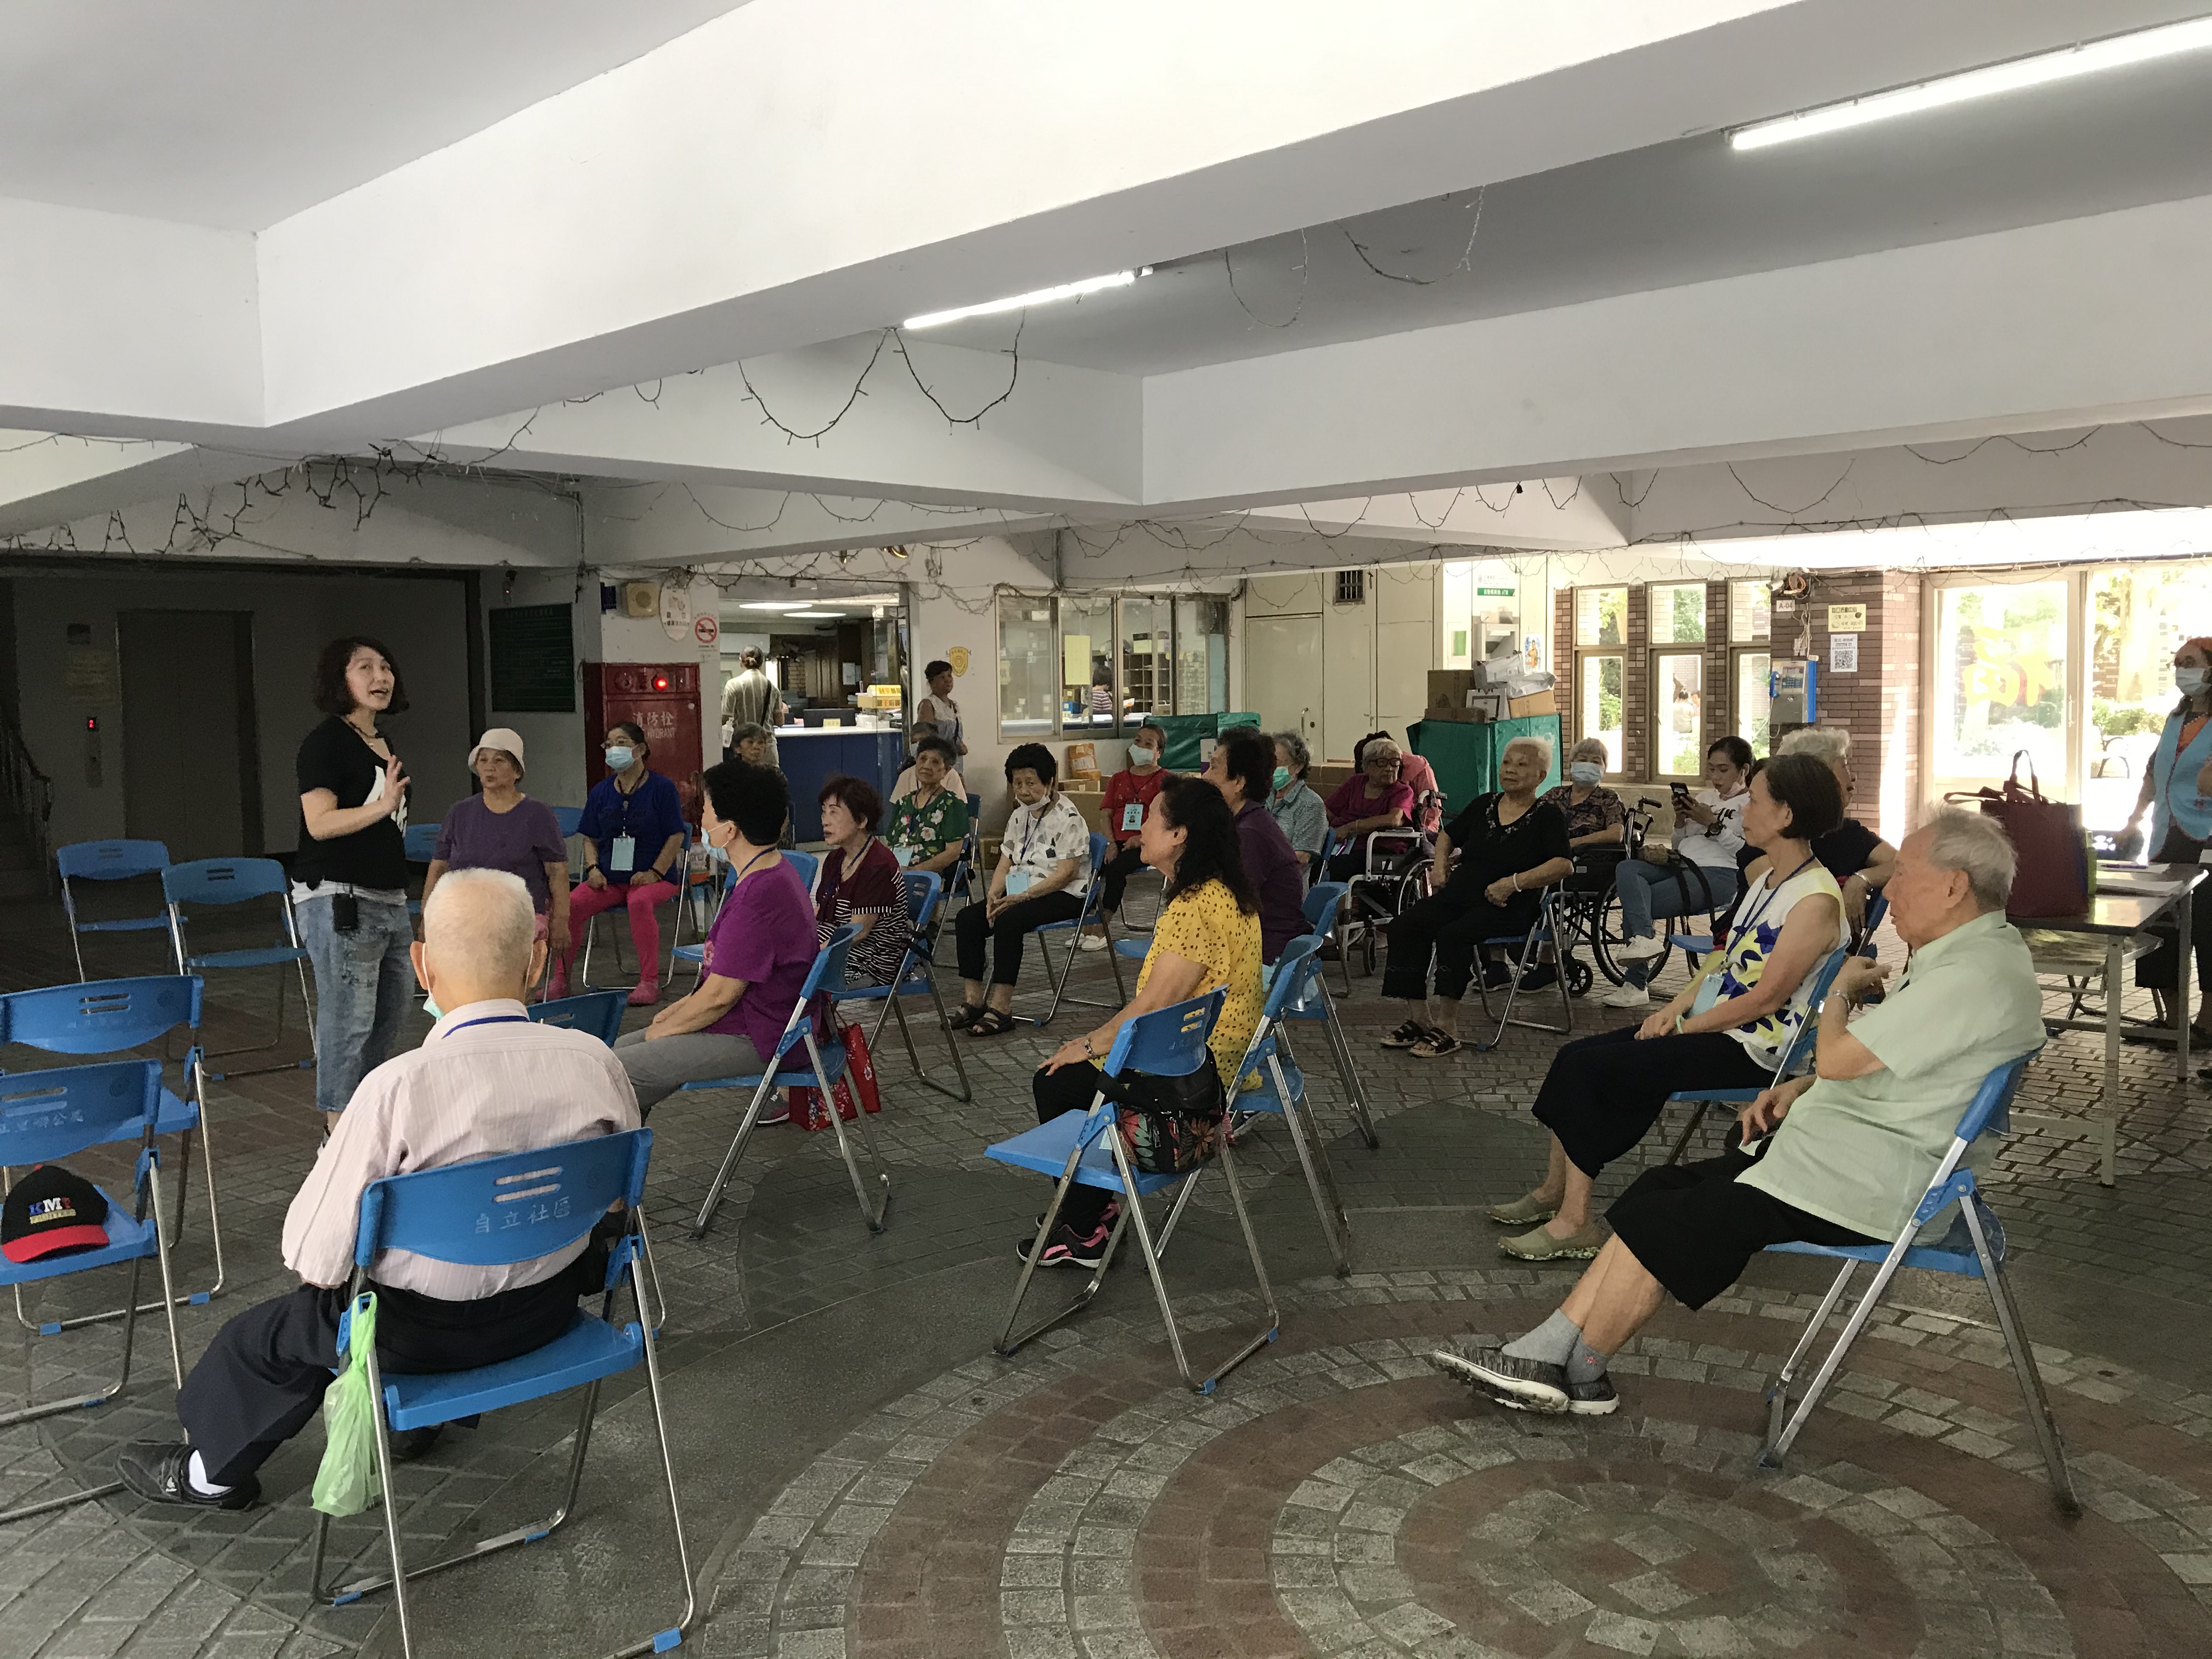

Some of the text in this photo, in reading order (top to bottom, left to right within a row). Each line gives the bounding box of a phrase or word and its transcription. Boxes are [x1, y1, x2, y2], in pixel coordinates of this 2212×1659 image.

[632, 711, 674, 728] 消防栓
[647, 727, 676, 739] HYDRANT
[29, 1197, 71, 1216] KMT
[476, 1196, 571, 1234] 自立社區
